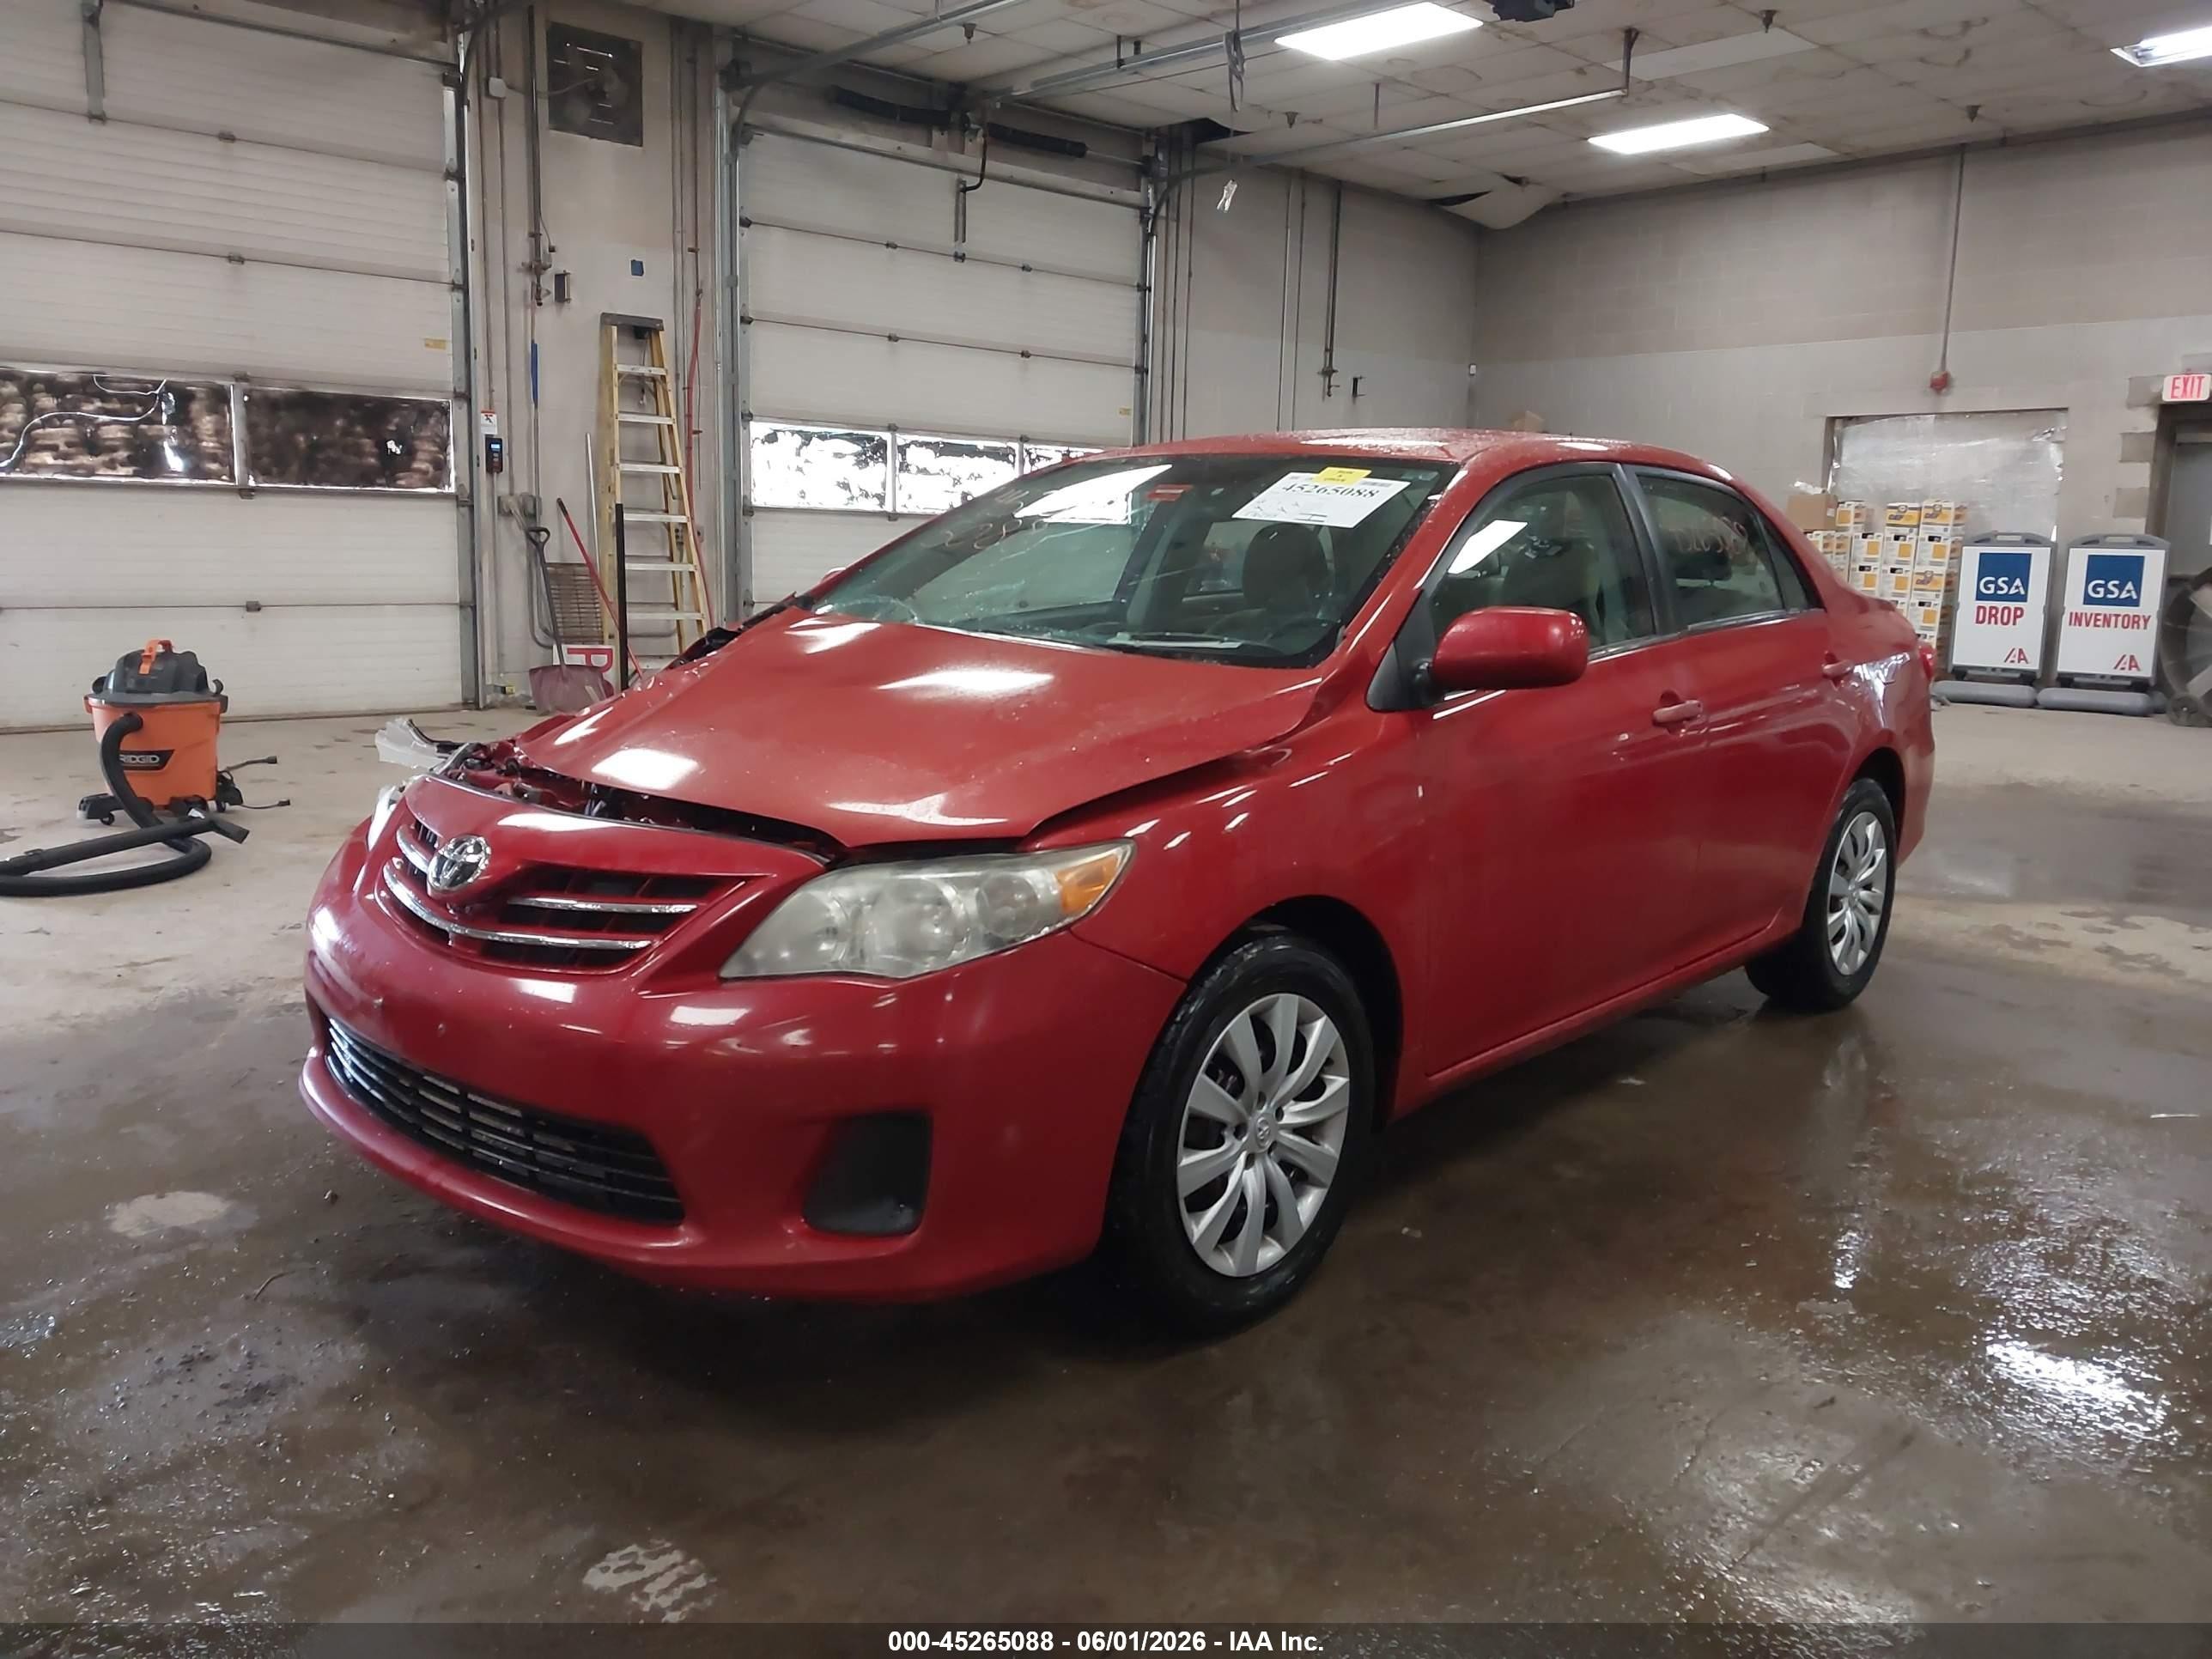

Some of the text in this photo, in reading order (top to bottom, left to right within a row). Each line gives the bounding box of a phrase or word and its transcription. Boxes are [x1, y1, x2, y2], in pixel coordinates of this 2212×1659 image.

[2170, 375, 2206, 399] EXIT
[1282, 483, 1380, 498] 45265088
[1978, 576, 2026, 595] GSA
[2087, 579, 2138, 599] GSA
[1975, 605, 2025, 626] DROP
[2069, 611, 2152, 630] INVENTORY
